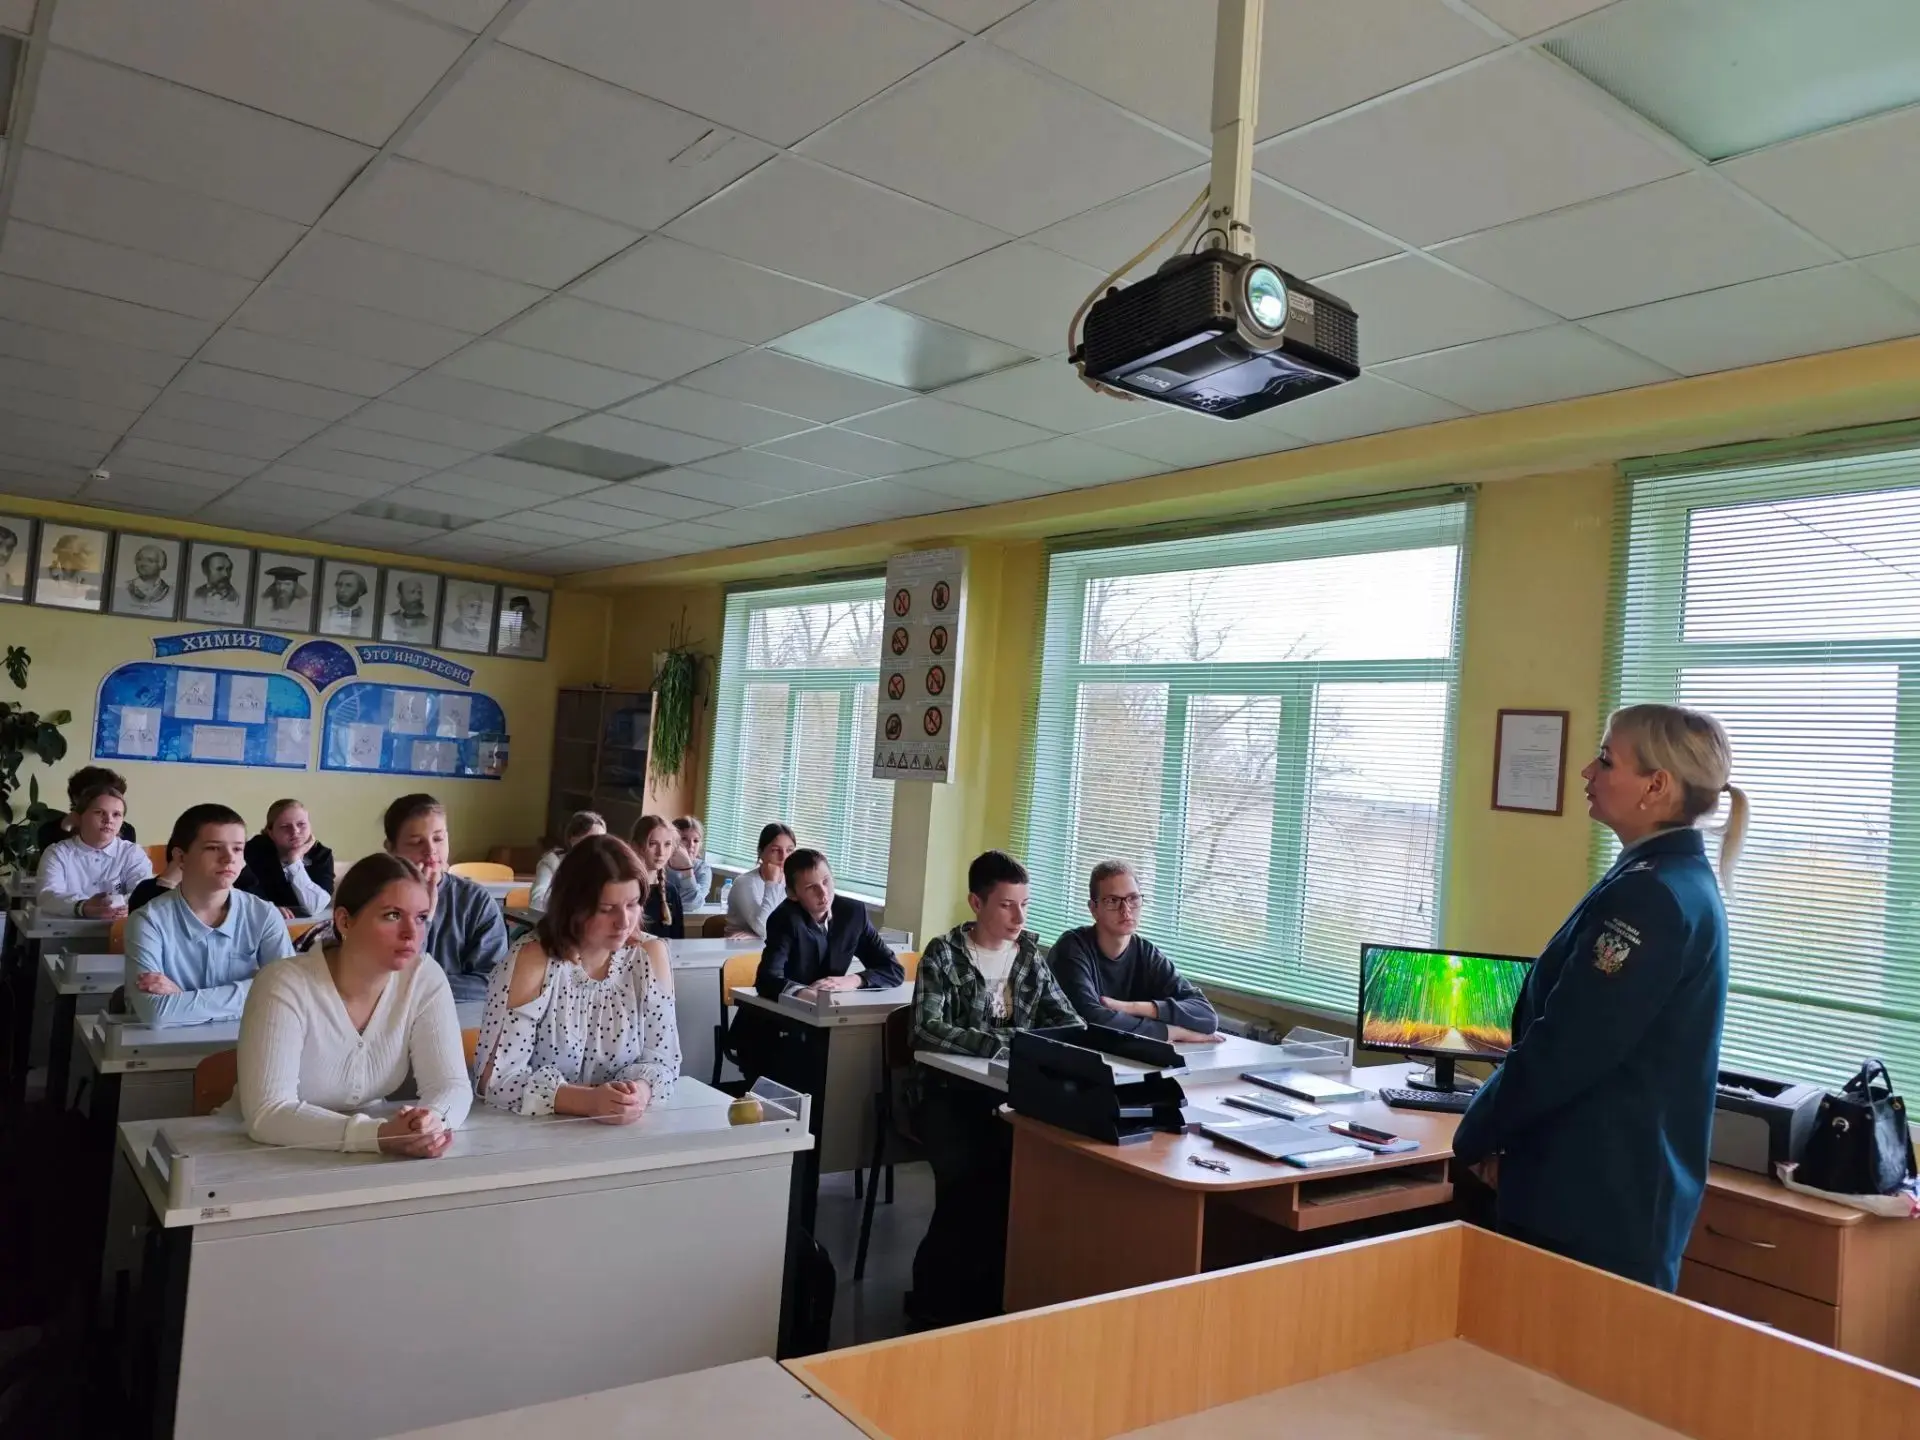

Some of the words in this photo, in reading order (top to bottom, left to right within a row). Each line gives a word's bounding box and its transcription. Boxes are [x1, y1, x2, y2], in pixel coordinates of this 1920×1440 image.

[181, 633, 261, 651] ХИМИЯ
[363, 648, 390, 660] ЭТО
[394, 651, 470, 682] ИНТЕРЕСНО
